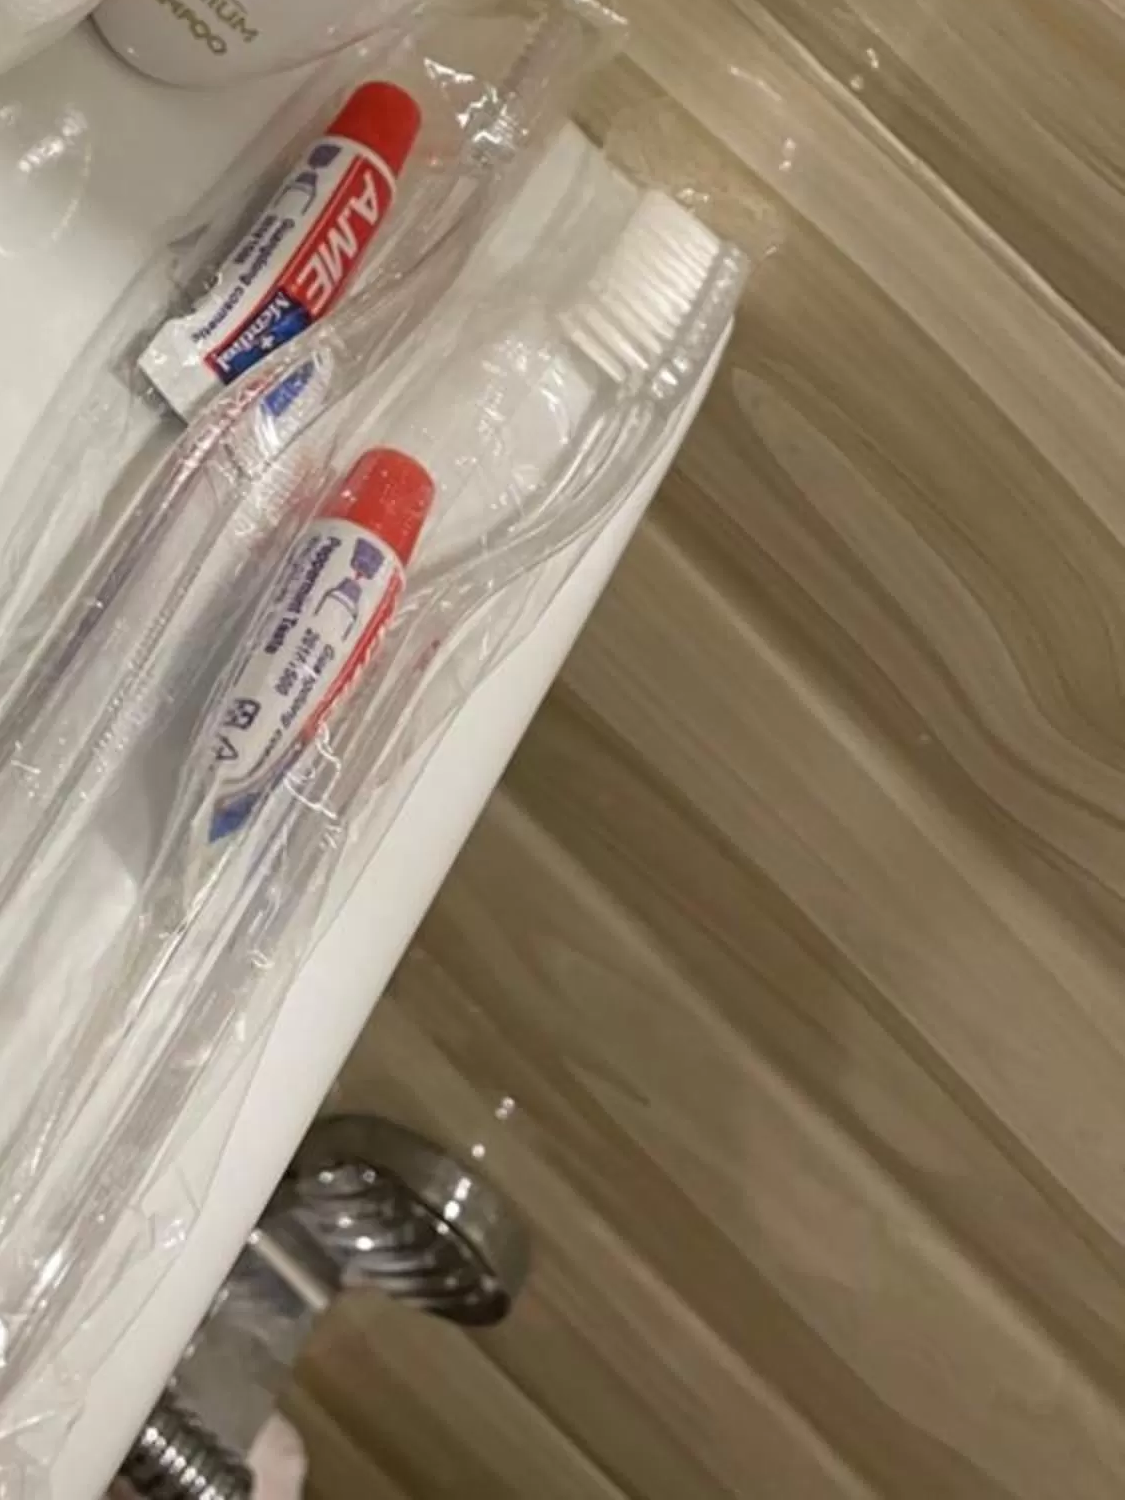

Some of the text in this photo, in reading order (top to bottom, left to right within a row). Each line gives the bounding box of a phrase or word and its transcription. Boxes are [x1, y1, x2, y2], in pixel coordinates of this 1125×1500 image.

[191, 286, 243, 343] cosmetic
[214, 290, 294, 371] Menthol
[263, 615, 301, 655] Taste
